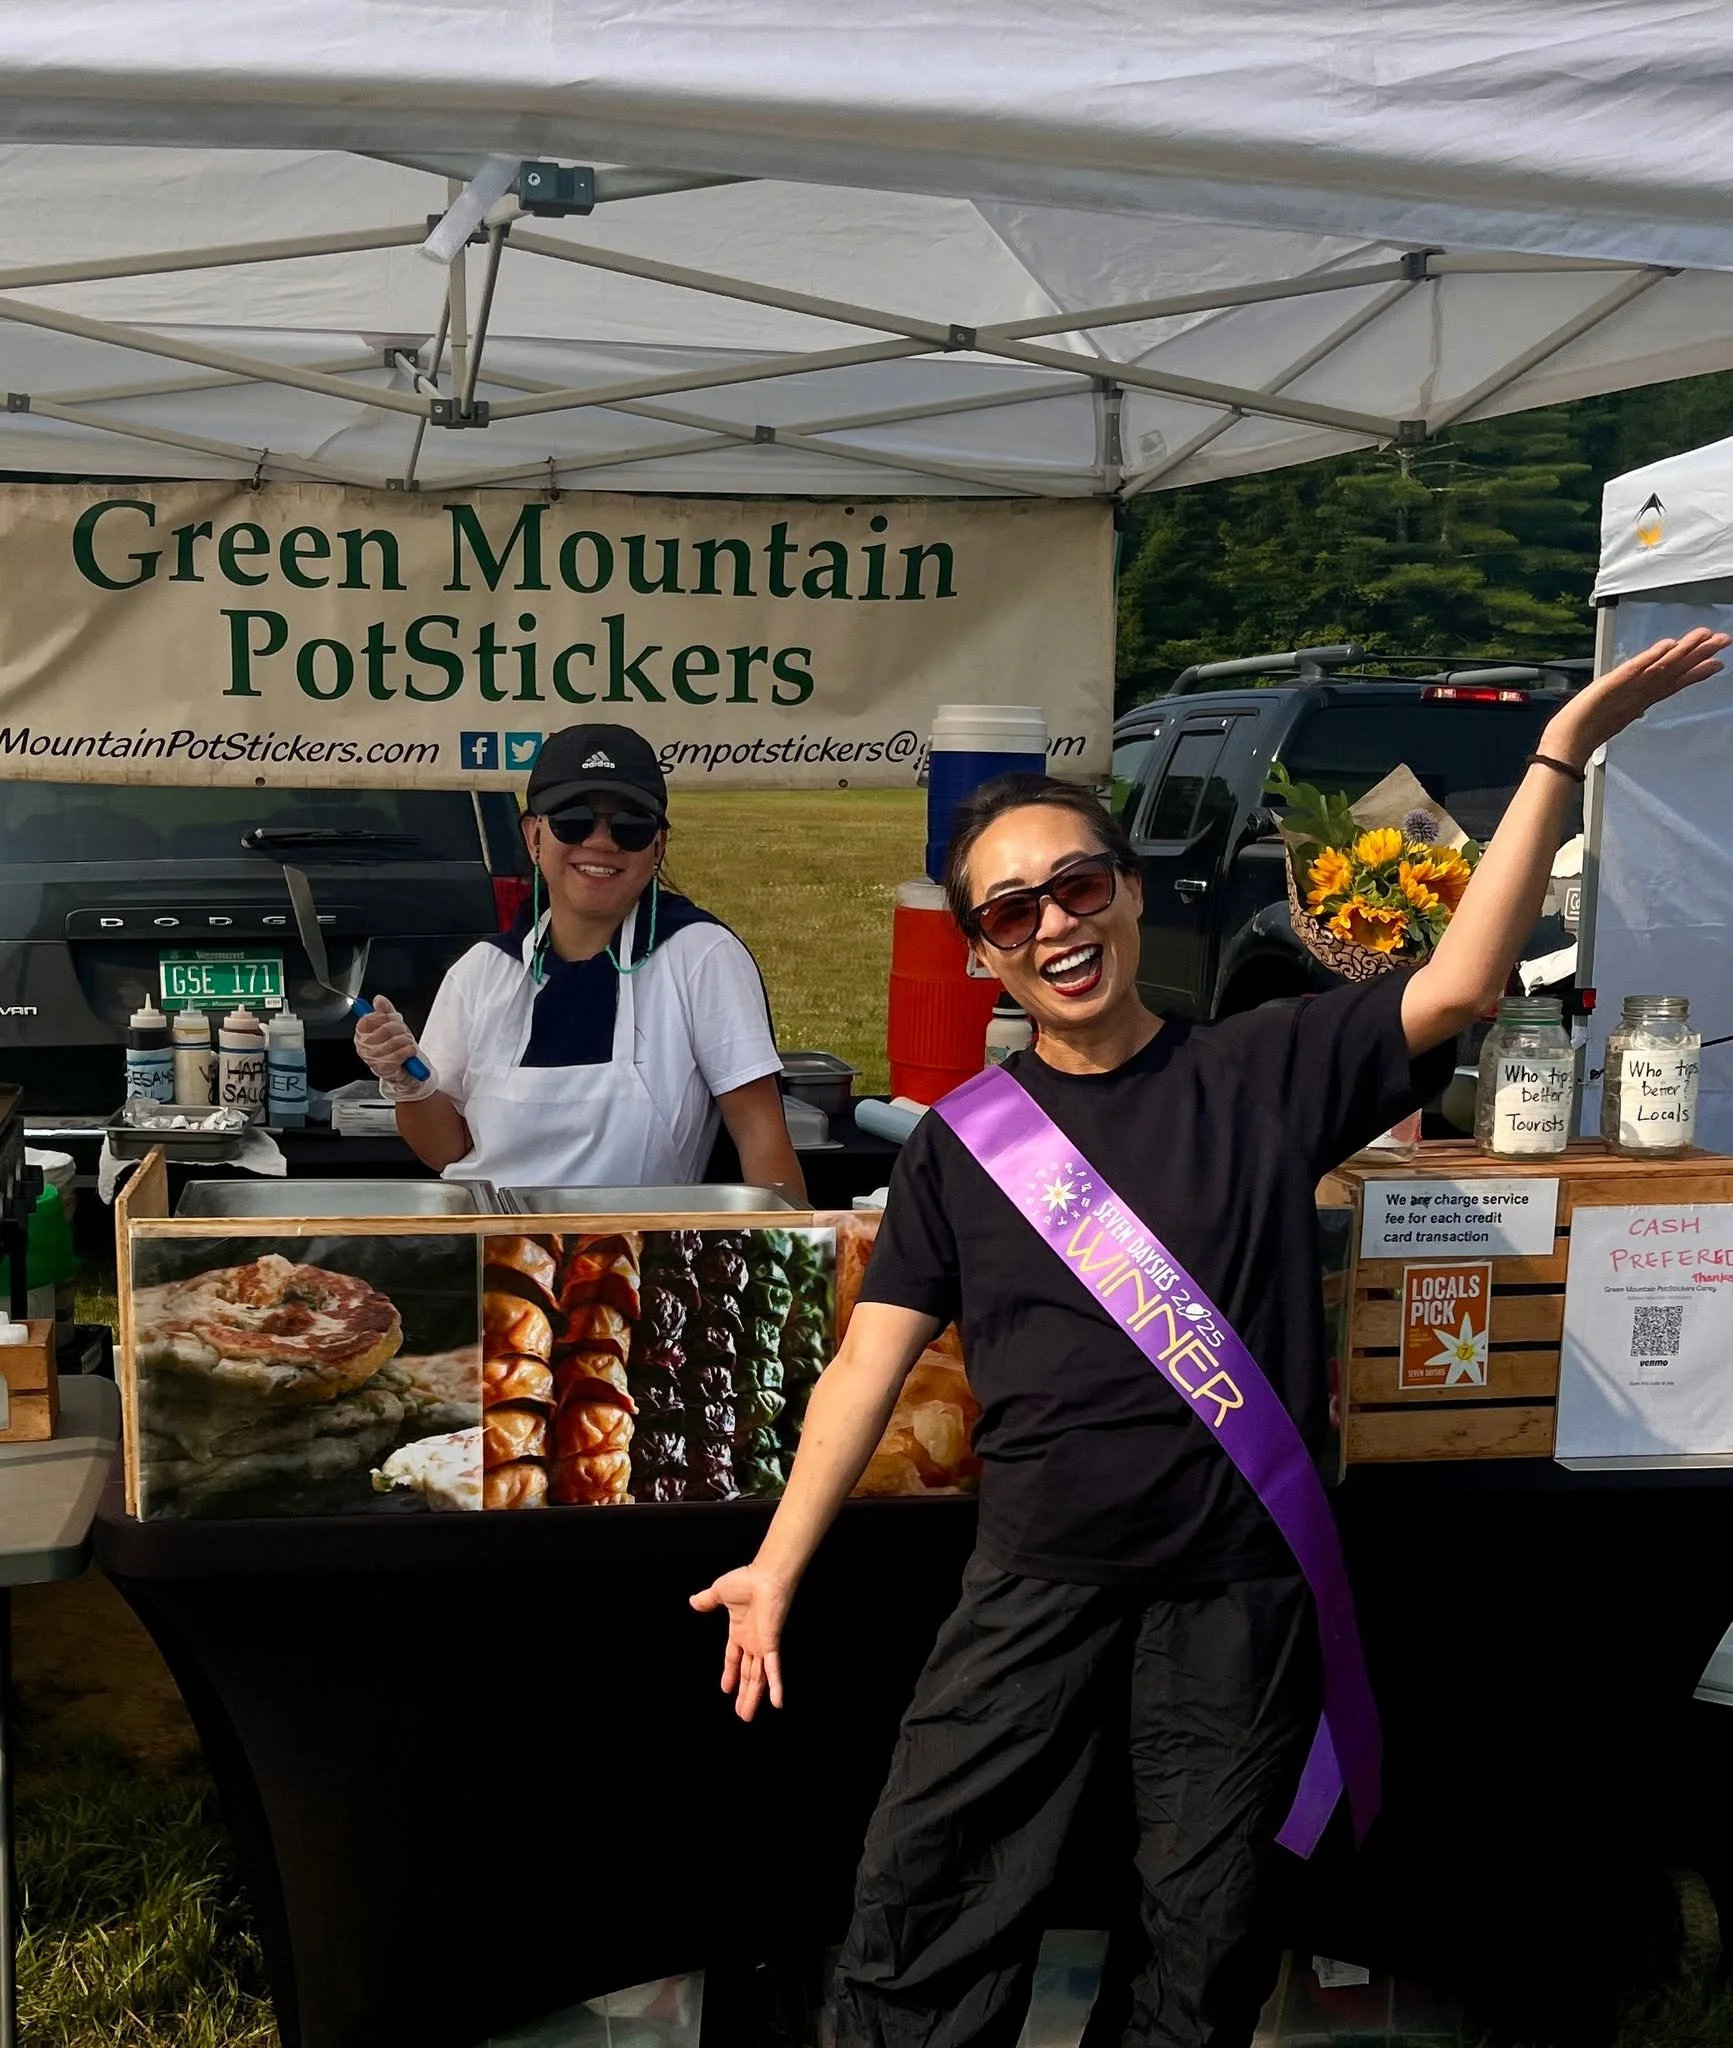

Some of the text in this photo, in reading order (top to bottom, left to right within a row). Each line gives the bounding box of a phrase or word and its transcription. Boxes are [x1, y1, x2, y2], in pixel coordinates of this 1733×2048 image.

[72, 499, 958, 601] Green Mountain
[219, 608, 815, 706] PotStickers
[0, 727, 440, 766] MountainPotStickers.com
[581, 760, 616, 769] adidas
[100, 915, 337, 928] DODGE
[172, 964, 275, 995] GSE 171
[1504, 1064, 1573, 1089] Who tips
[1629, 1059, 1699, 1080] Who tips
[1504, 1112, 1565, 1133] Tourists
[1637, 1102, 1690, 1122] Locals
[1386, 1194, 1407, 1206] We
[1434, 1194, 1479, 1208] charge
[1482, 1193, 1530, 1205] service
[1385, 1211, 1503, 1225] fee for each credit
[1628, 1216, 1700, 1237] CASH
[1092, 1200, 1137, 1244] SEVEN
[1126, 1236, 1181, 1292] DAYSIES
[1383, 1230, 1490, 1243] card transaction
[1412, 1275, 1480, 1301] LOCALS
[1065, 1215, 1245, 1429] WINNER
[1410, 1299, 1456, 1327] PICK
[1639, 1359, 1669, 1367] venmo
